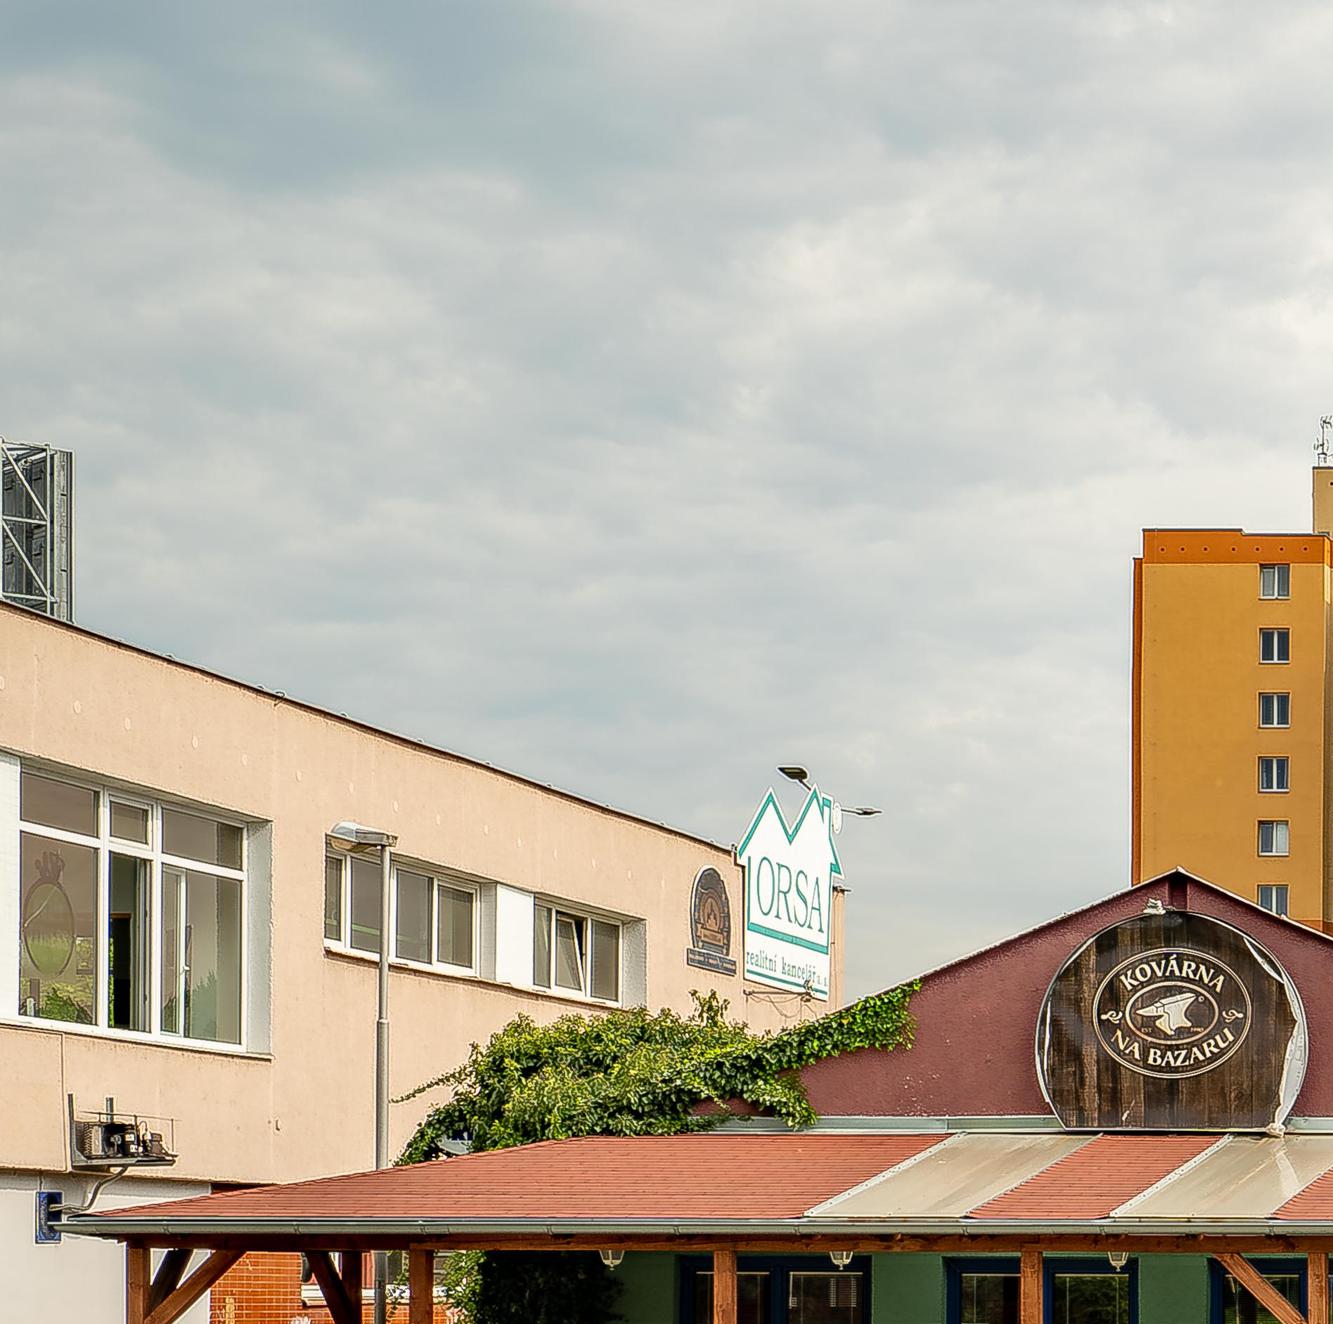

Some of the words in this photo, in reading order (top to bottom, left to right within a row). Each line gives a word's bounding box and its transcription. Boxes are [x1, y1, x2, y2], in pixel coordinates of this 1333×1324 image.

[757, 856, 825, 934] ORSA
[746, 949, 777, 973] realitní
[1119, 954, 1225, 994] KOVÁRNA
[1110, 1029, 1141, 1061] NA
[1147, 1027, 1236, 1067] BAZARU
